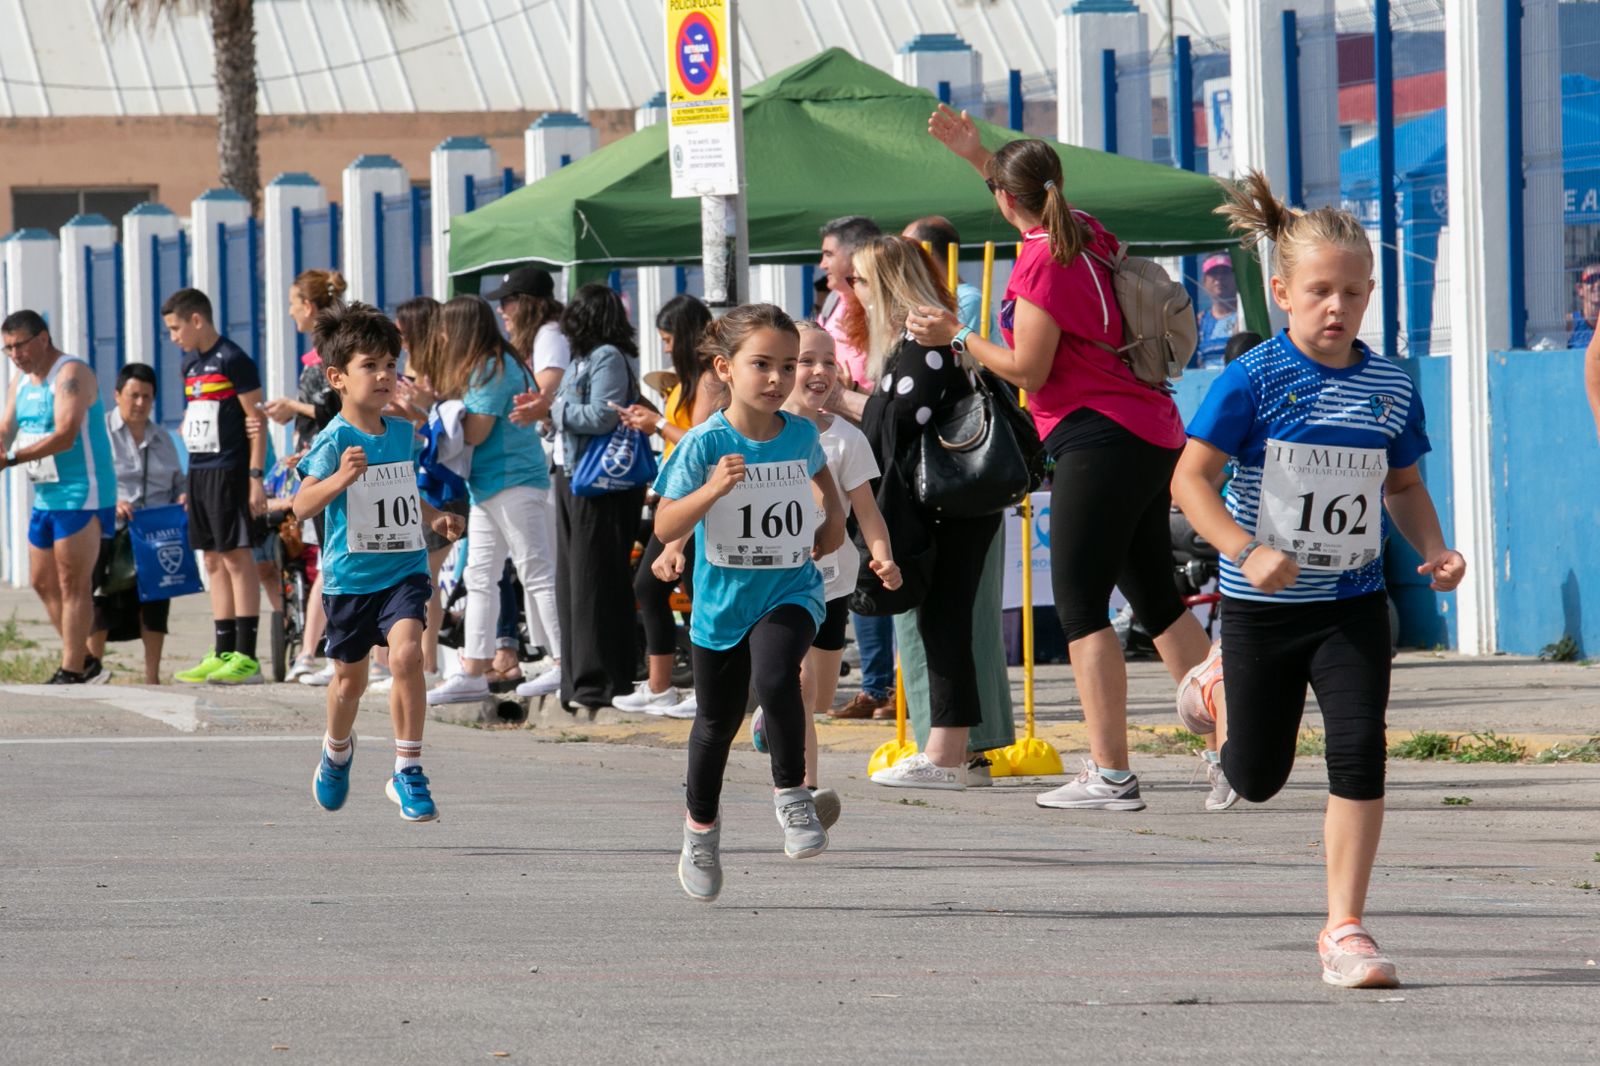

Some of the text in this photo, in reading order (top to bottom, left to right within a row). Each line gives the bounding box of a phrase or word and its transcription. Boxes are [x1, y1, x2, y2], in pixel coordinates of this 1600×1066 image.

[189, 420, 210, 437] 137
[1288, 464, 1333, 476] POPULAR
[1306, 448, 1383, 470] MILLA
[373, 494, 419, 529] 103
[737, 500, 803, 539] 160
[1293, 491, 1367, 535] 162
